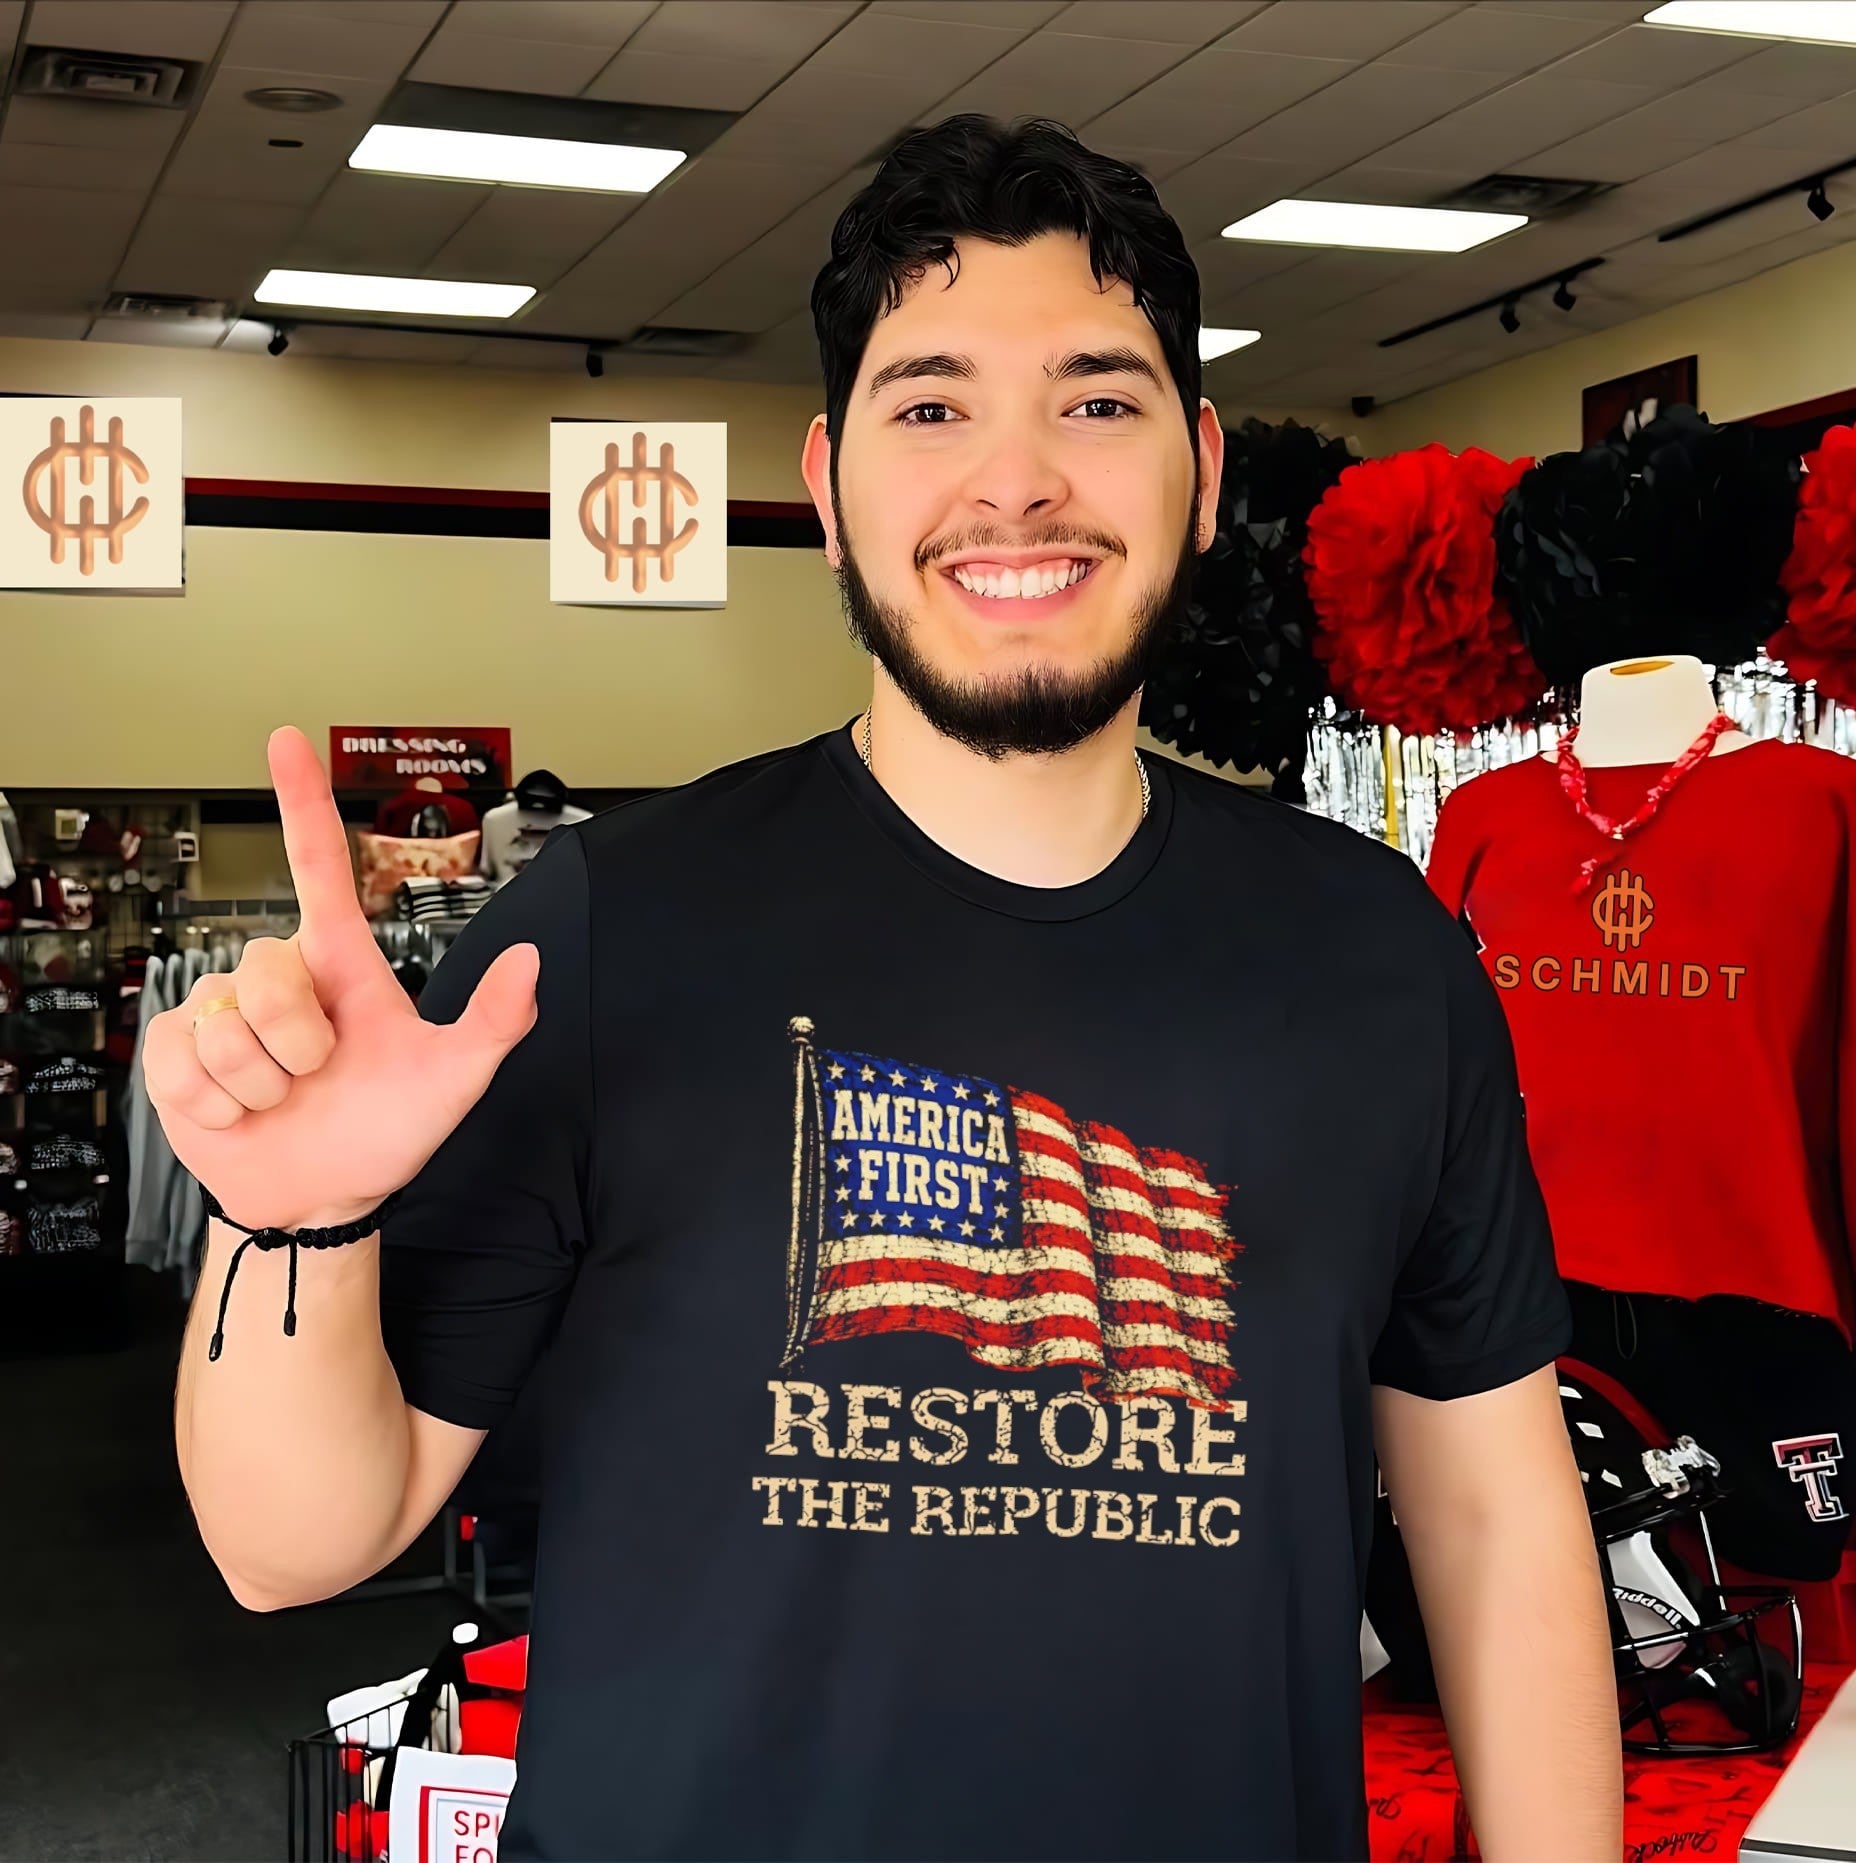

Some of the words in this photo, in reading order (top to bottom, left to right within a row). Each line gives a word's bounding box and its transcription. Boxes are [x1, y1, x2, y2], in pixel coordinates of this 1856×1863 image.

[396, 758, 487, 775] ROOMS
[1493, 954, 1747, 1001] SCHMIDT
[831, 1089, 1010, 1165] AMERICA
[857, 1149, 988, 1215] FIRST
[764, 1379, 1248, 1476] RESTORE
[751, 1475, 891, 1533] THE
[909, 1484, 1242, 1548] REPUBLIC
